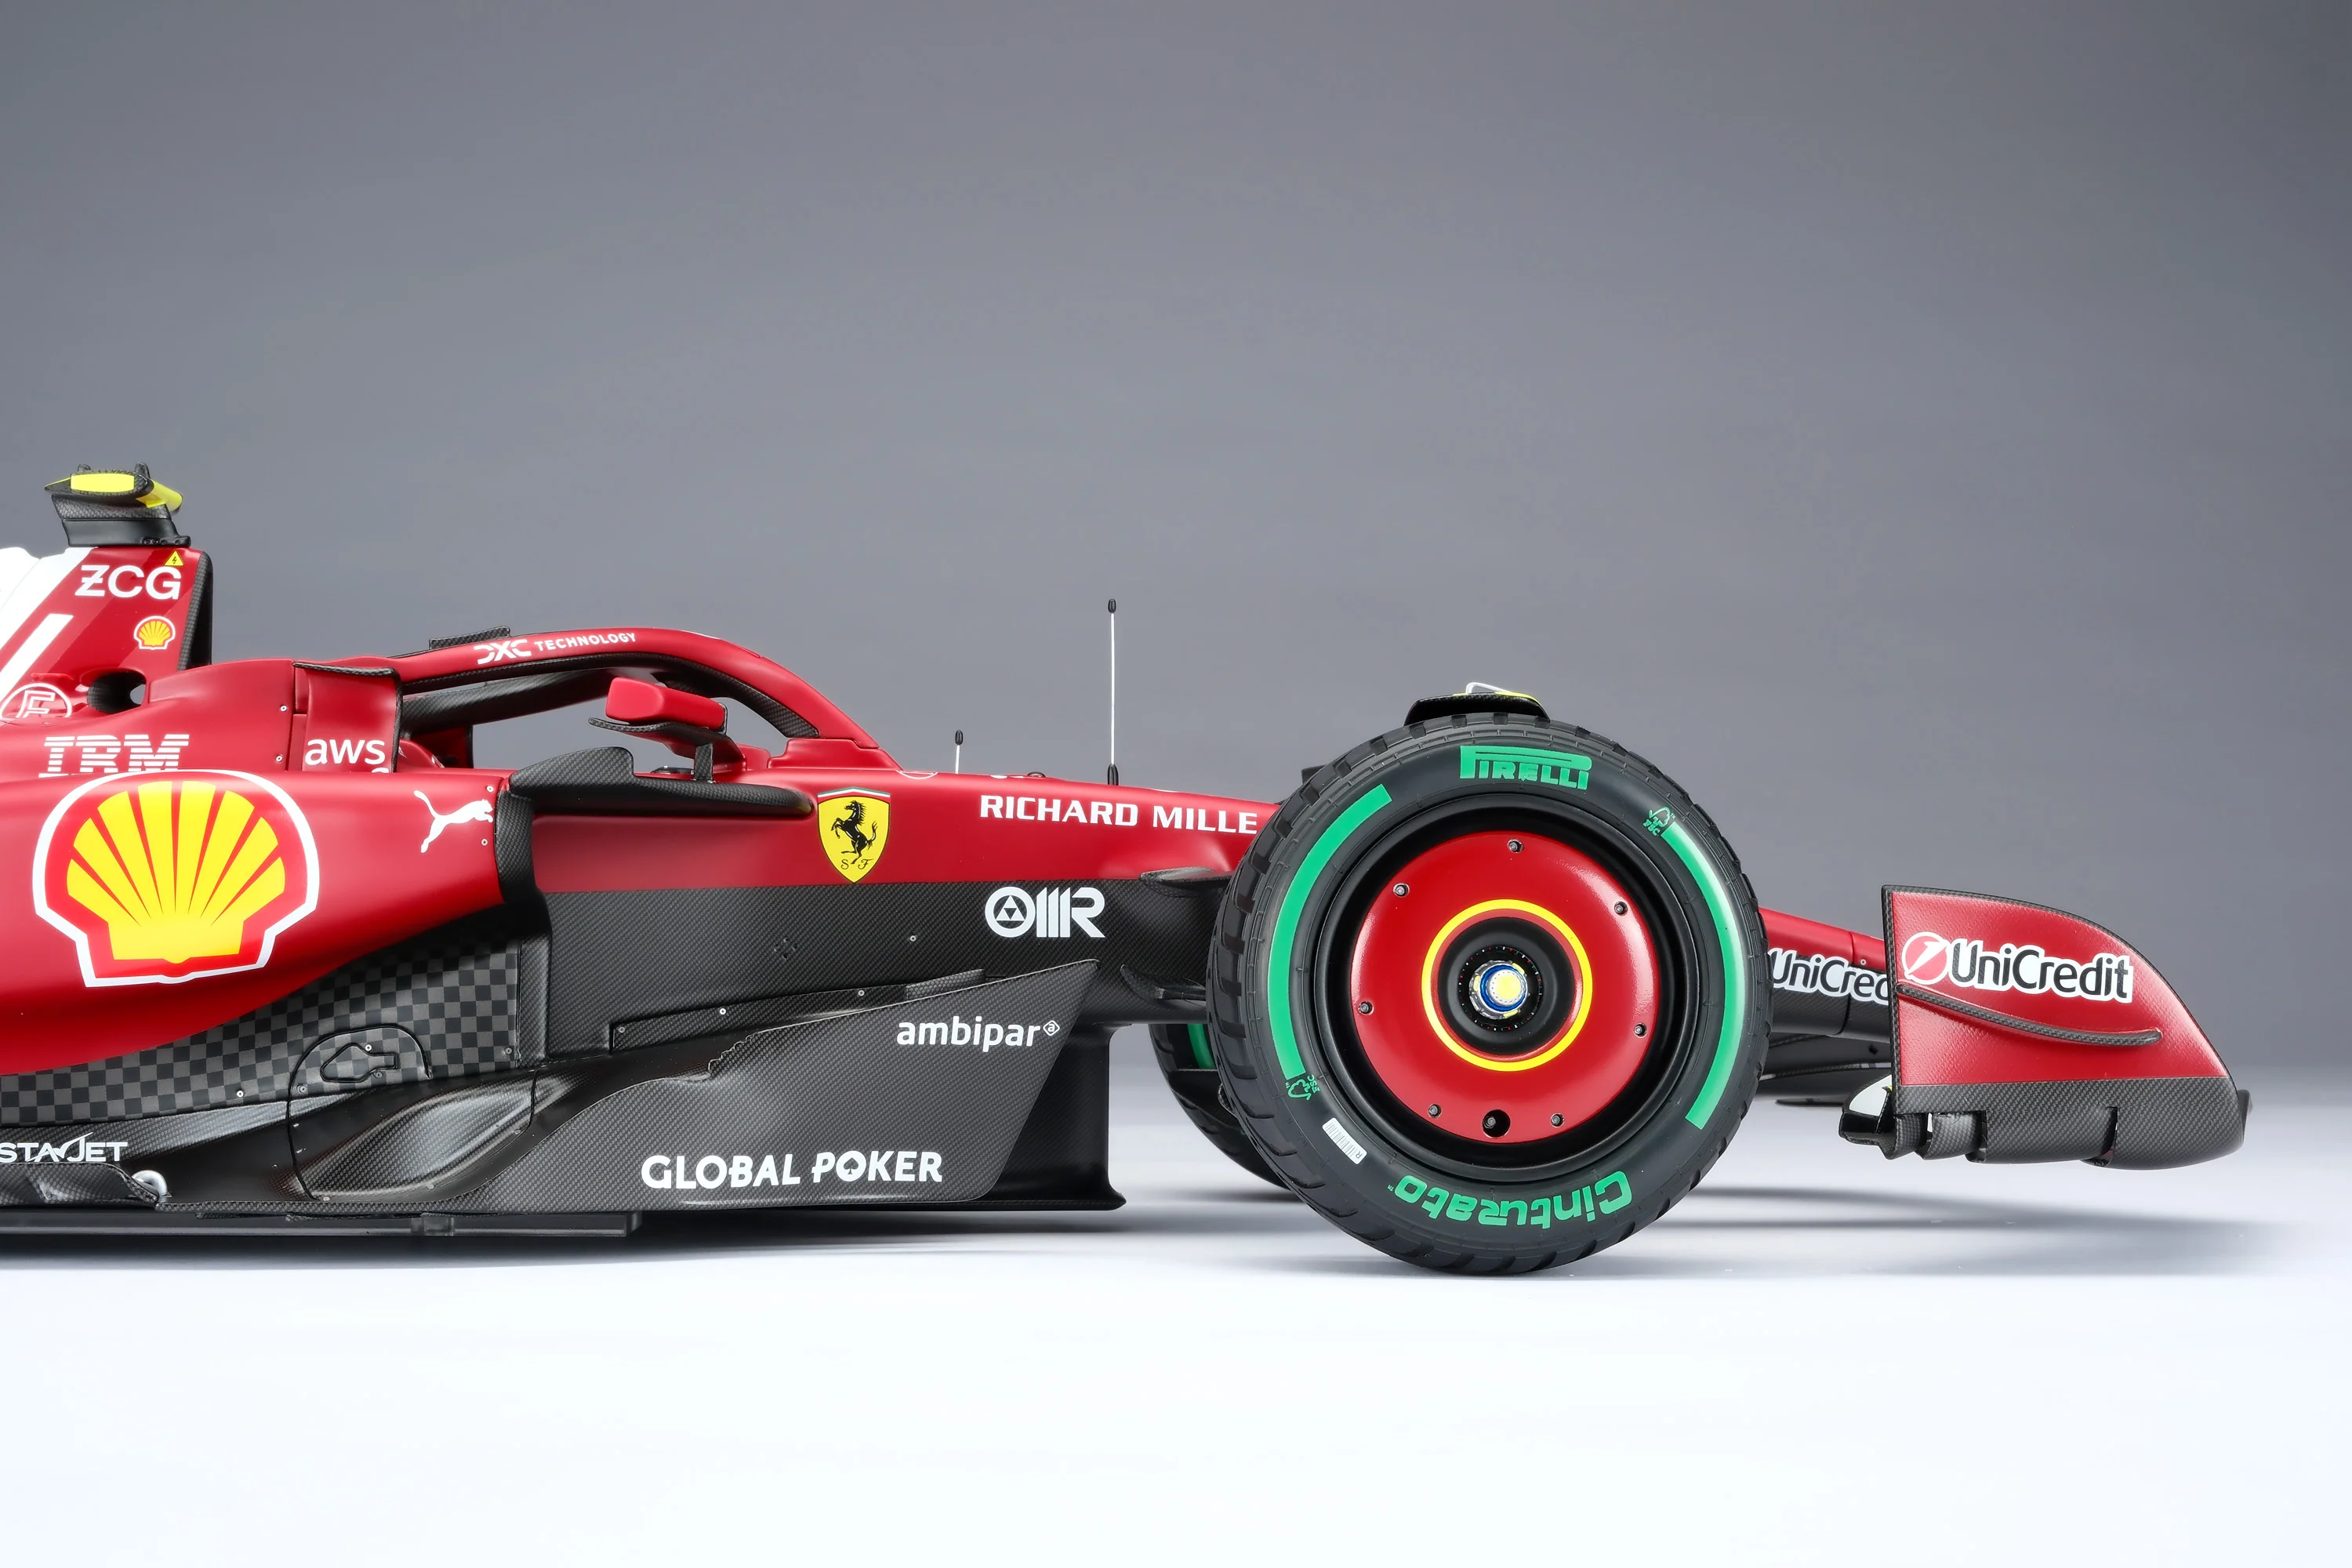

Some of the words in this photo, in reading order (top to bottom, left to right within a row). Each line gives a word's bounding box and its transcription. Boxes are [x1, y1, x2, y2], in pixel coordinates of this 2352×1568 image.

[474, 639, 532, 665] DXC
[534, 633, 636, 652] TECHNOLOGY
[304, 739, 386, 766] aws
[1460, 746, 1592, 790] PIRELLI
[980, 795, 1138, 827] RICHARD
[1152, 805, 1258, 835] MILLE
[1951, 942, 2129, 999] UniCredit
[897, 1016, 1040, 1053] ambipar
[1307, 1074, 1320, 1094] FSC
[641, 1154, 801, 1189] GLOBAL
[811, 1150, 942, 1183] POKER
[1394, 1171, 1632, 1229] Cinturato
